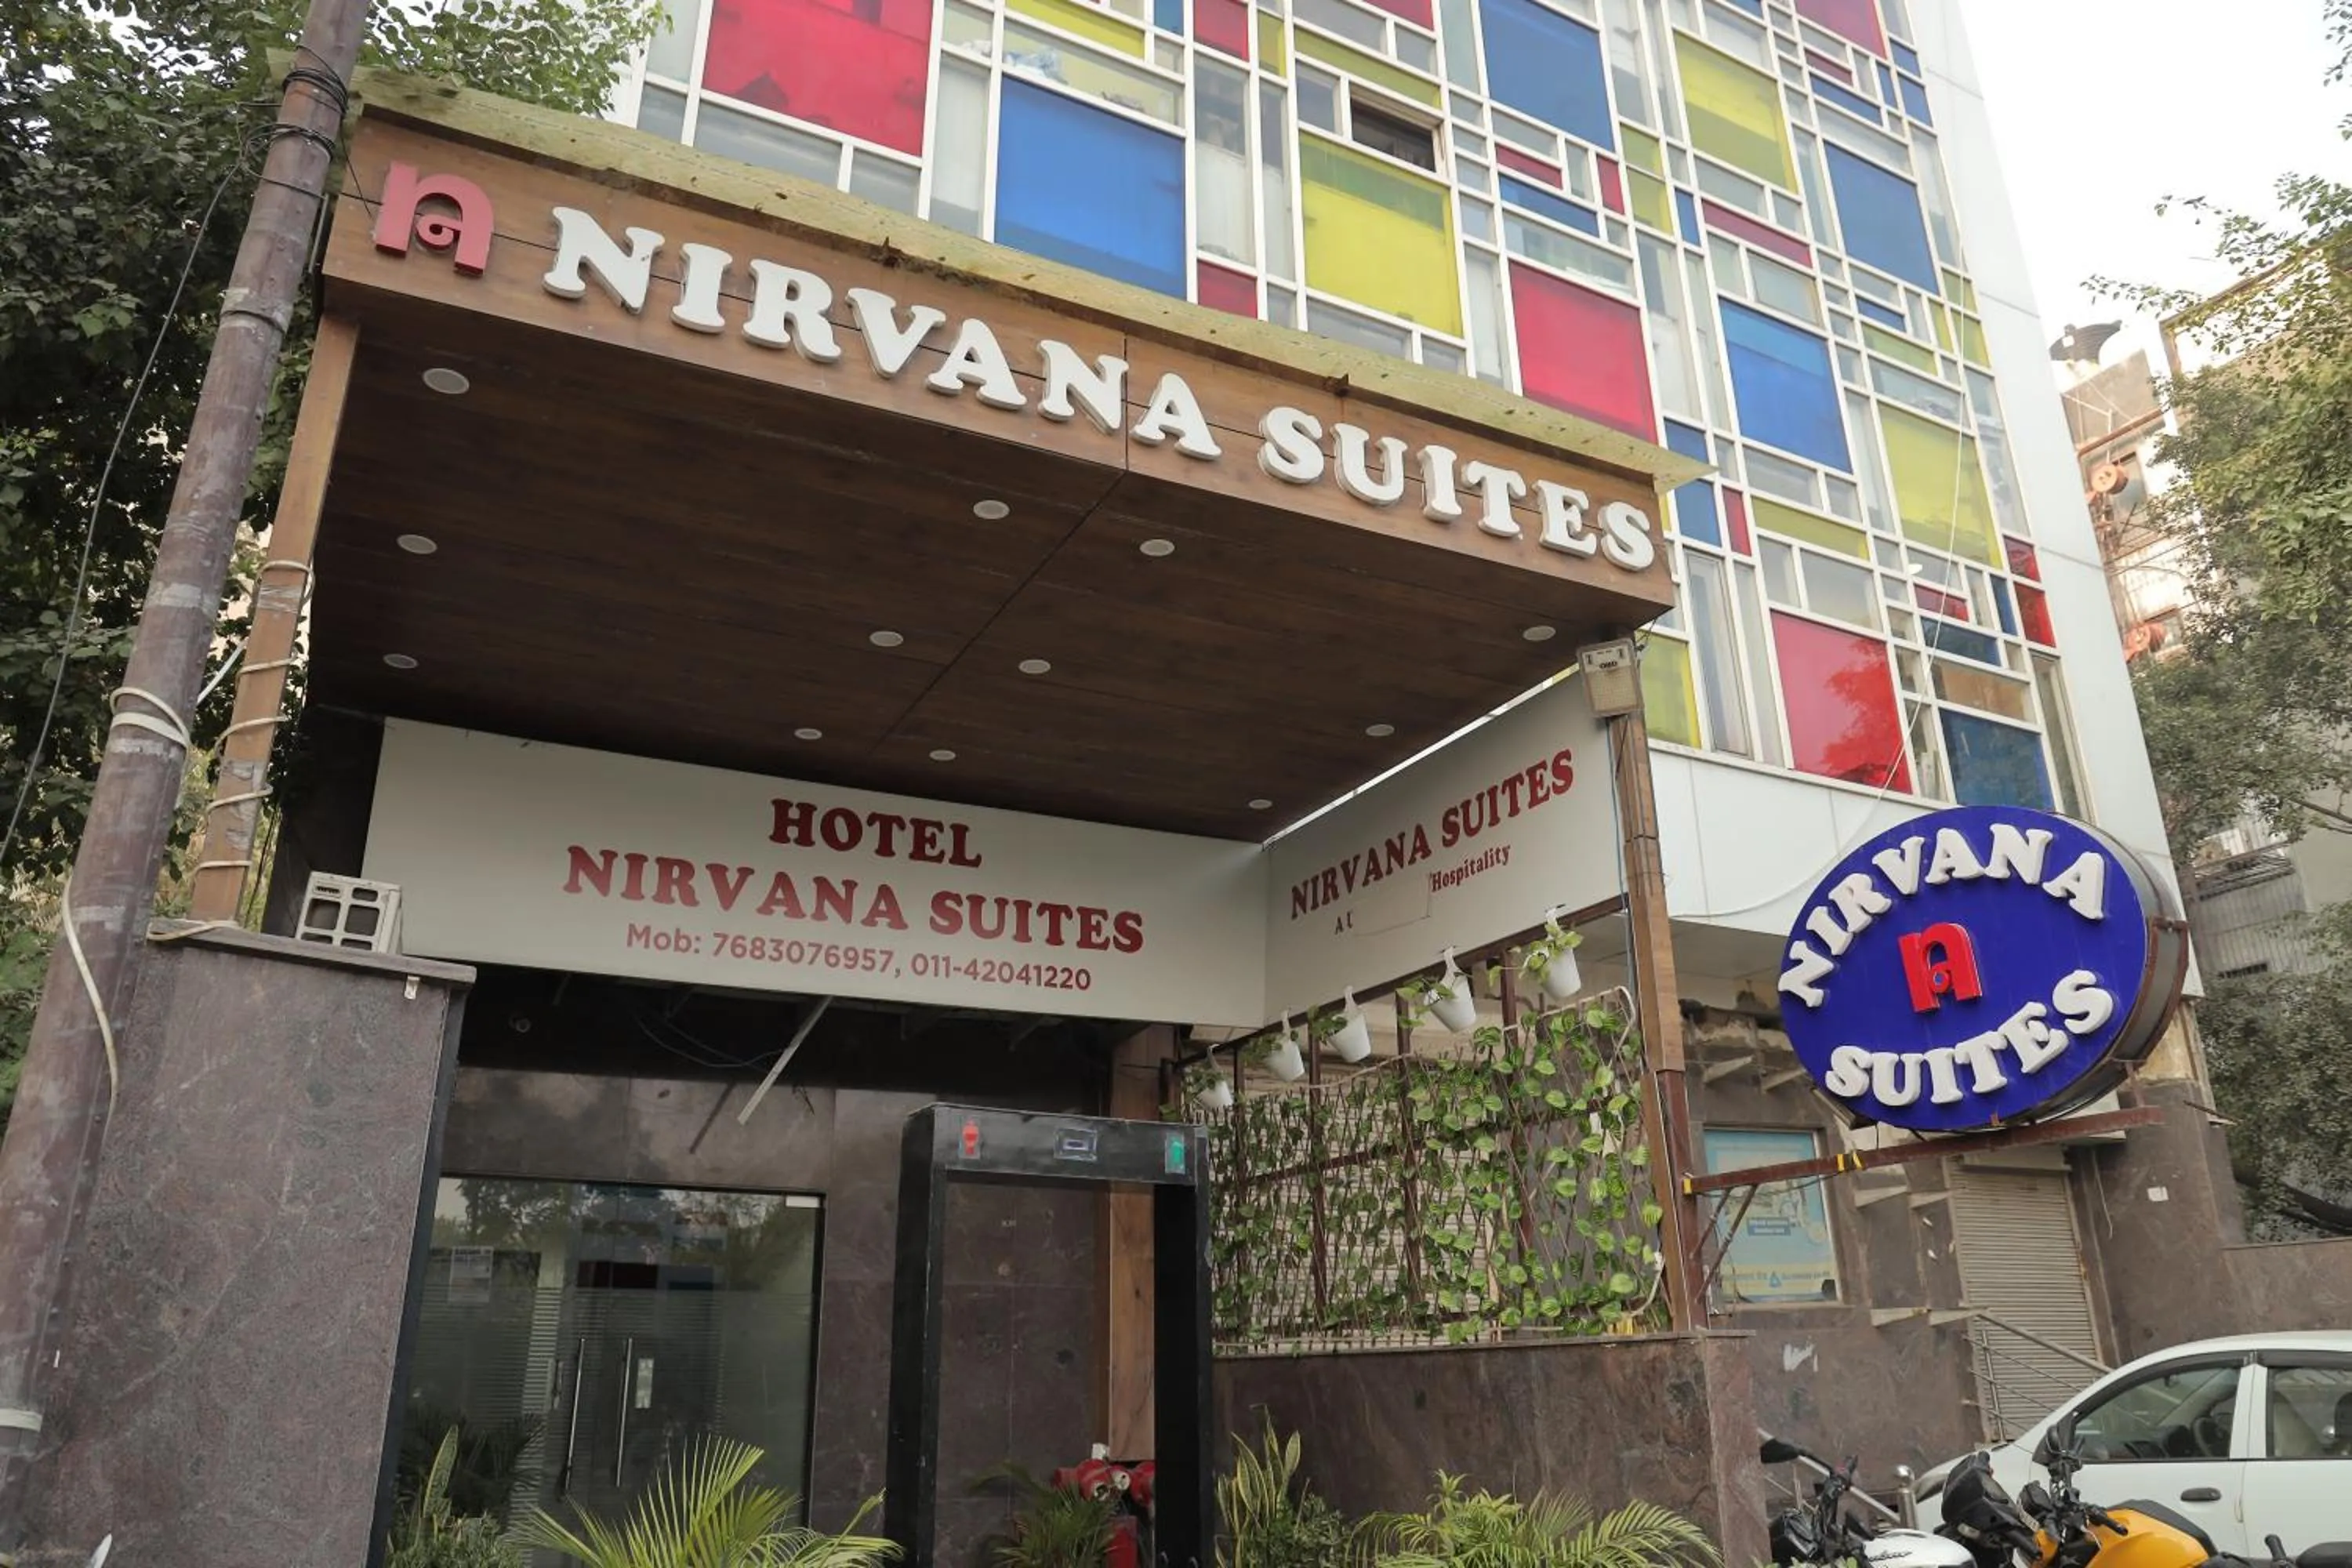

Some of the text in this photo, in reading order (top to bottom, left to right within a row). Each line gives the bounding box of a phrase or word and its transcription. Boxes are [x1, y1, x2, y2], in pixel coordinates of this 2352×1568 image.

[543, 206, 1221, 460] NIRVANA
[1257, 406, 1654, 572] SUITES
[768, 798, 982, 868] HOTEL
[1291, 750, 1574, 920] NIRVANA SUITES
[1432, 845, 1510, 892] Hospitality
[563, 846, 1145, 953] NIRVANA SUITES
[627, 923, 1091, 990] Mob: 7683076957, 011-42041220
[1778, 823, 2104, 1007] NIRVANA
[1825, 970, 2114, 1106] SUITES
